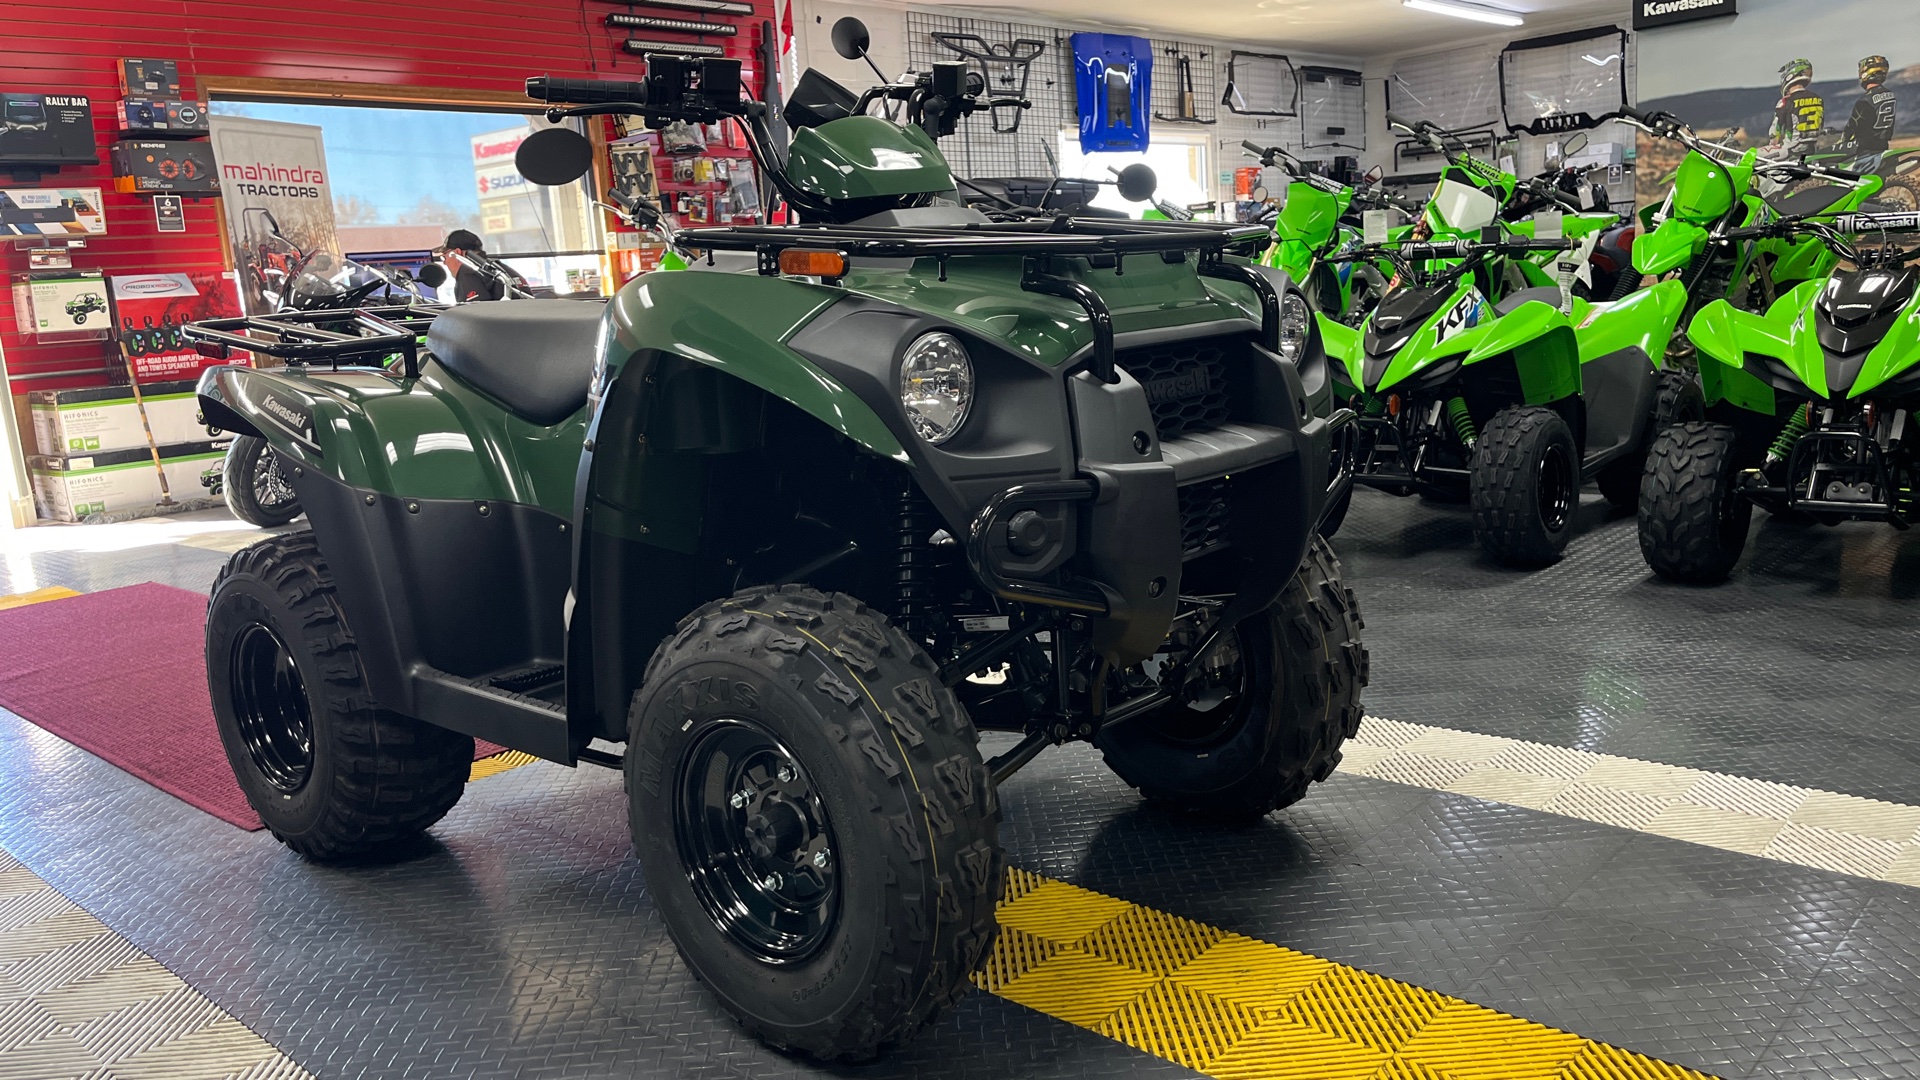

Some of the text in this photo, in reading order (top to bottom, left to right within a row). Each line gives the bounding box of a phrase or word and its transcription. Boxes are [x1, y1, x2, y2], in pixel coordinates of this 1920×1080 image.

[1643, 0, 1724, 17] Kawasa
[45, 97, 88, 106] RALLY BAR
[1793, 97, 1823, 108] TOMAC
[1795, 107, 1824, 132] 3
[1873, 100, 1897, 130] 2
[474, 134, 528, 159] Kawasa
[223, 162, 324, 184] mahindra
[490, 174, 526, 189] SUZU
[237, 184, 319, 198] TRACTORS
[164, 198, 172, 206] 6
[1856, 217, 1915, 230] Kawasaki
[1431, 286, 1482, 346] KFX
[136, 356, 162, 366] OFF-ROAD
[162, 355, 177, 364] AUDIO
[137, 360, 199, 372] AND TOWER SPEAKER KIT
[1143, 366, 1212, 403] wasaki
[64, 411, 98, 419] HIFONICS
[262, 394, 307, 429] Kawasaki
[69, 476, 104, 485] HIFONICS
[640, 675, 762, 798] MAXXIS
